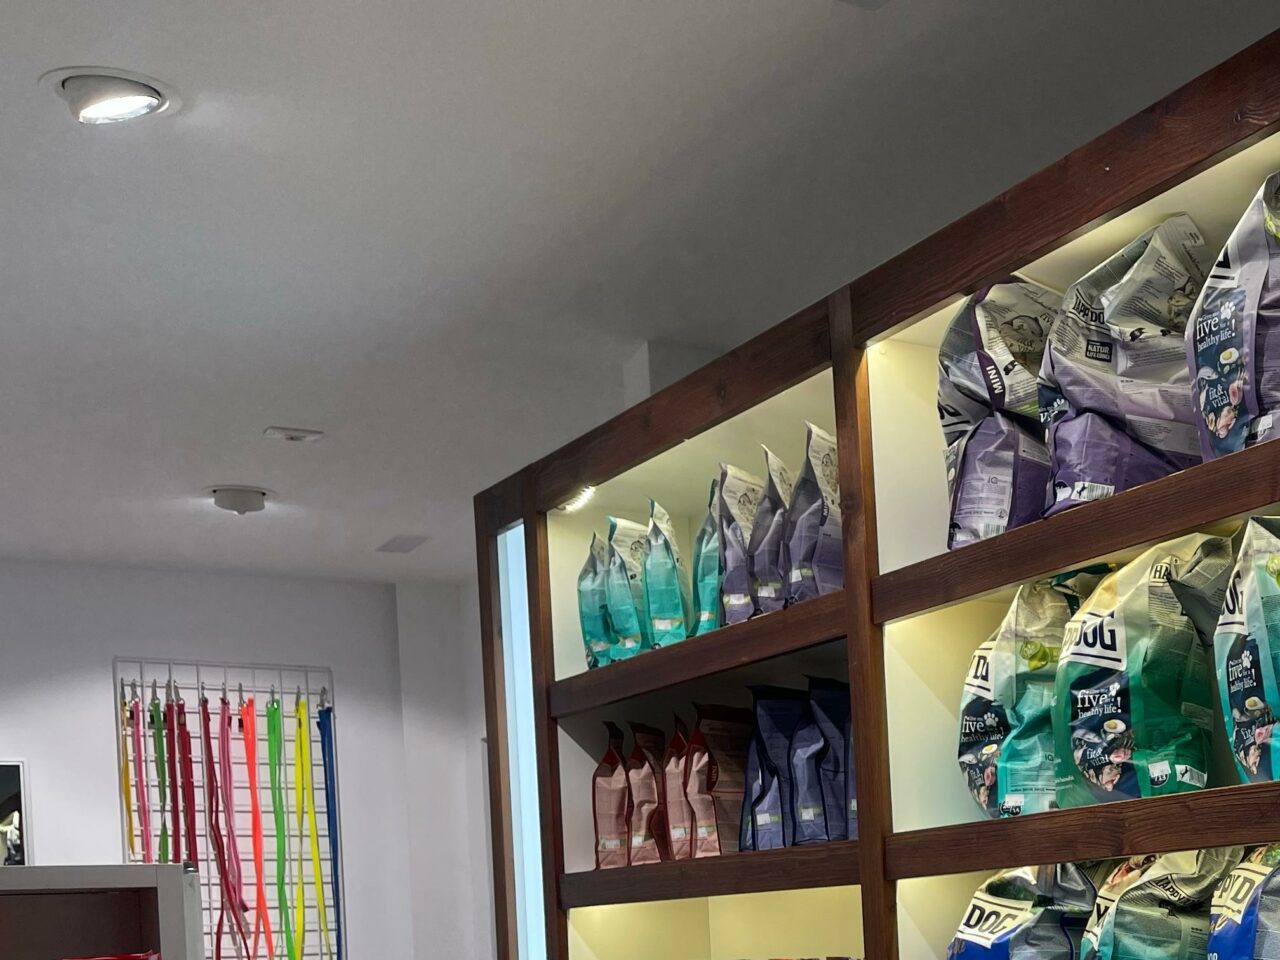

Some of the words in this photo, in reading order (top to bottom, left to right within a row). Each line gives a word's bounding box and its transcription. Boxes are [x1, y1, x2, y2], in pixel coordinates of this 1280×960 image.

[1196, 317, 1219, 340] five
[1197, 334, 1220, 352] healthy
[986, 365, 1004, 395] MINI
[1212, 390, 1229, 409] vital
[1077, 690, 1108, 708] five
[962, 715, 986, 733] five
